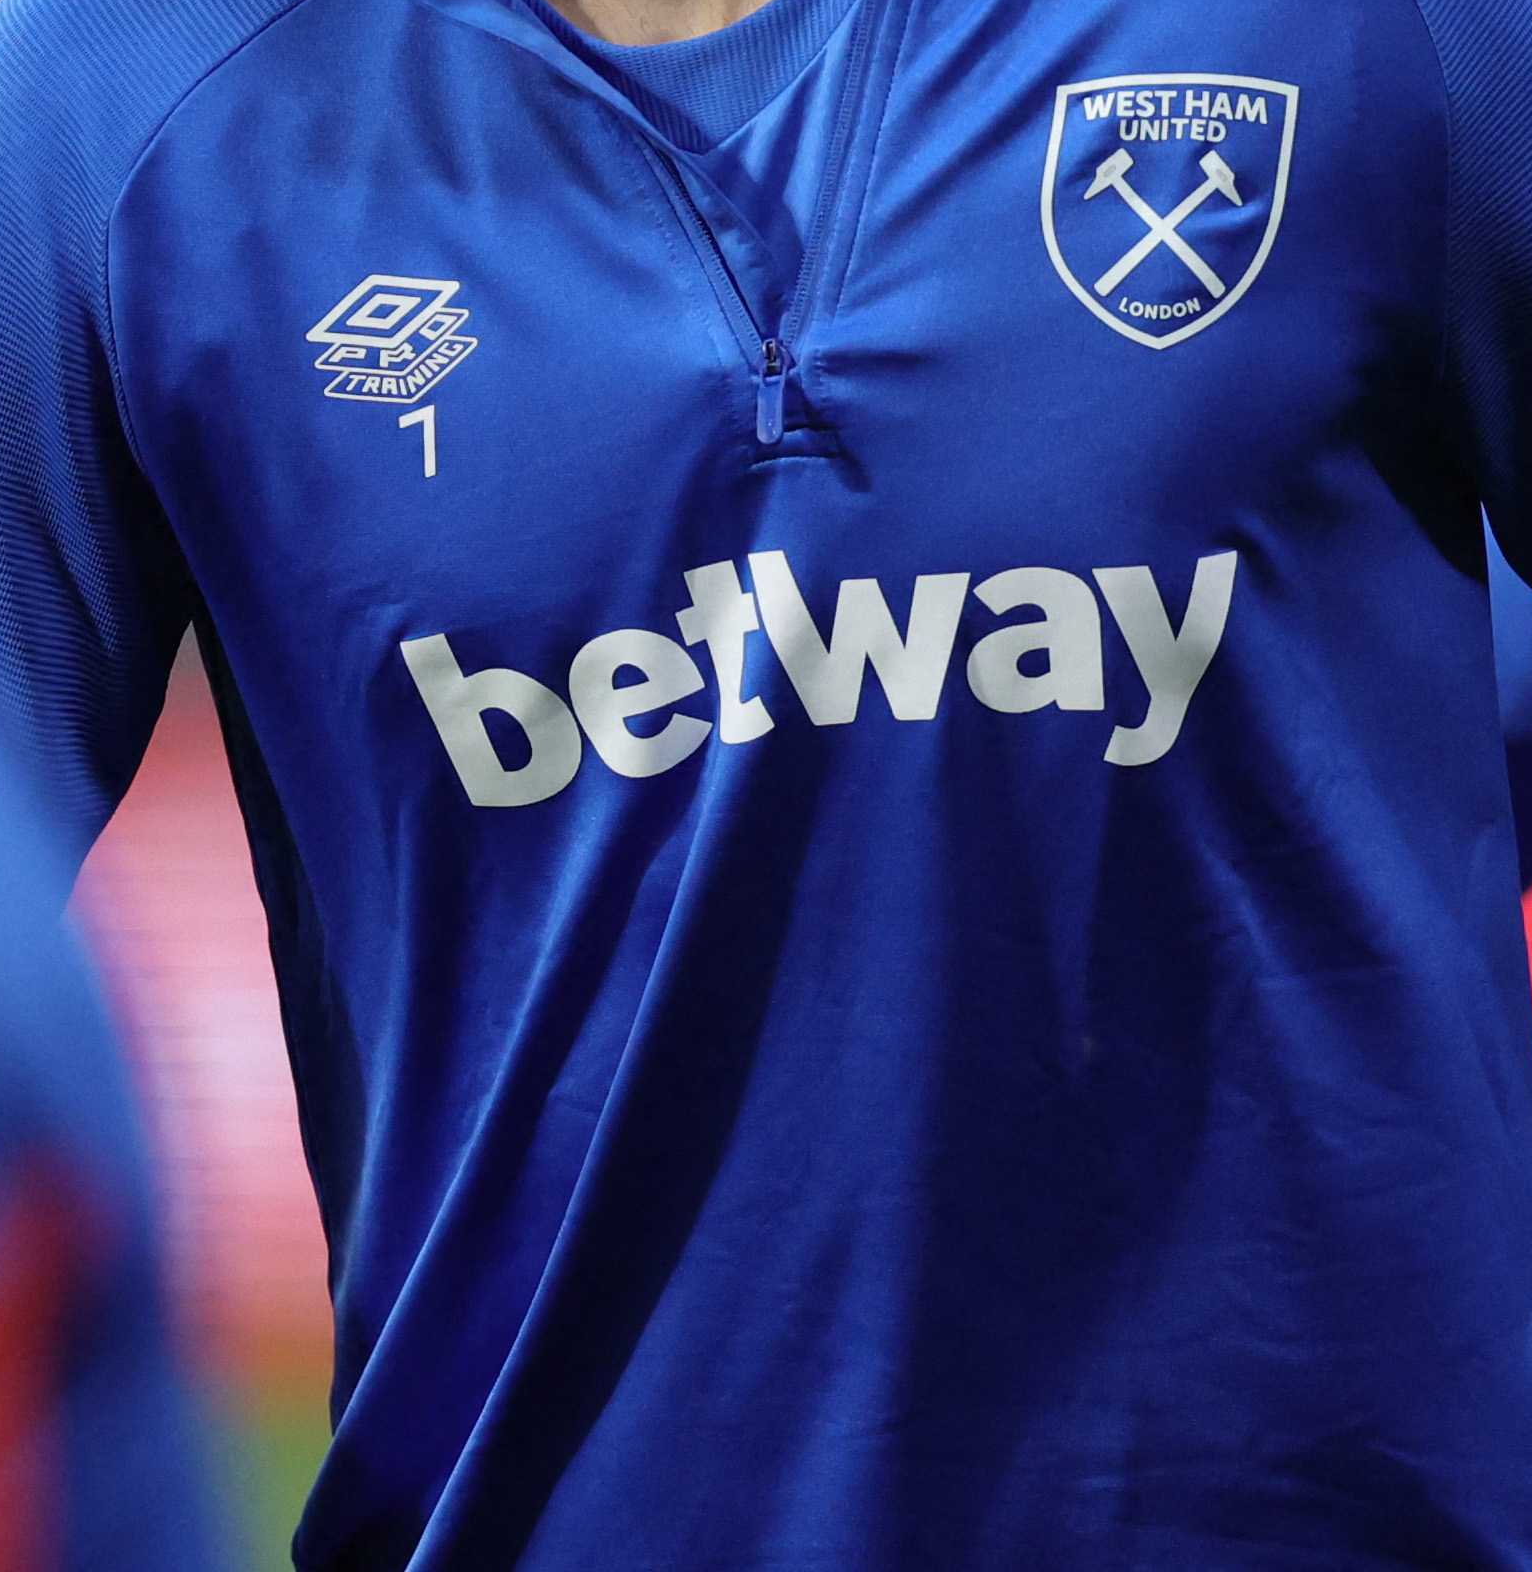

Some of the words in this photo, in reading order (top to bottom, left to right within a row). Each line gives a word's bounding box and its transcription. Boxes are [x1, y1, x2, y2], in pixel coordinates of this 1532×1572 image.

[1083, 89, 1177, 121] WEST
[1184, 89, 1268, 125] HAM
[1119, 117, 1227, 143] UNITED
[1118, 296, 1201, 320] LONDON
[345, 342, 465, 395] TRAINING
[399, 548, 1238, 808] betway
